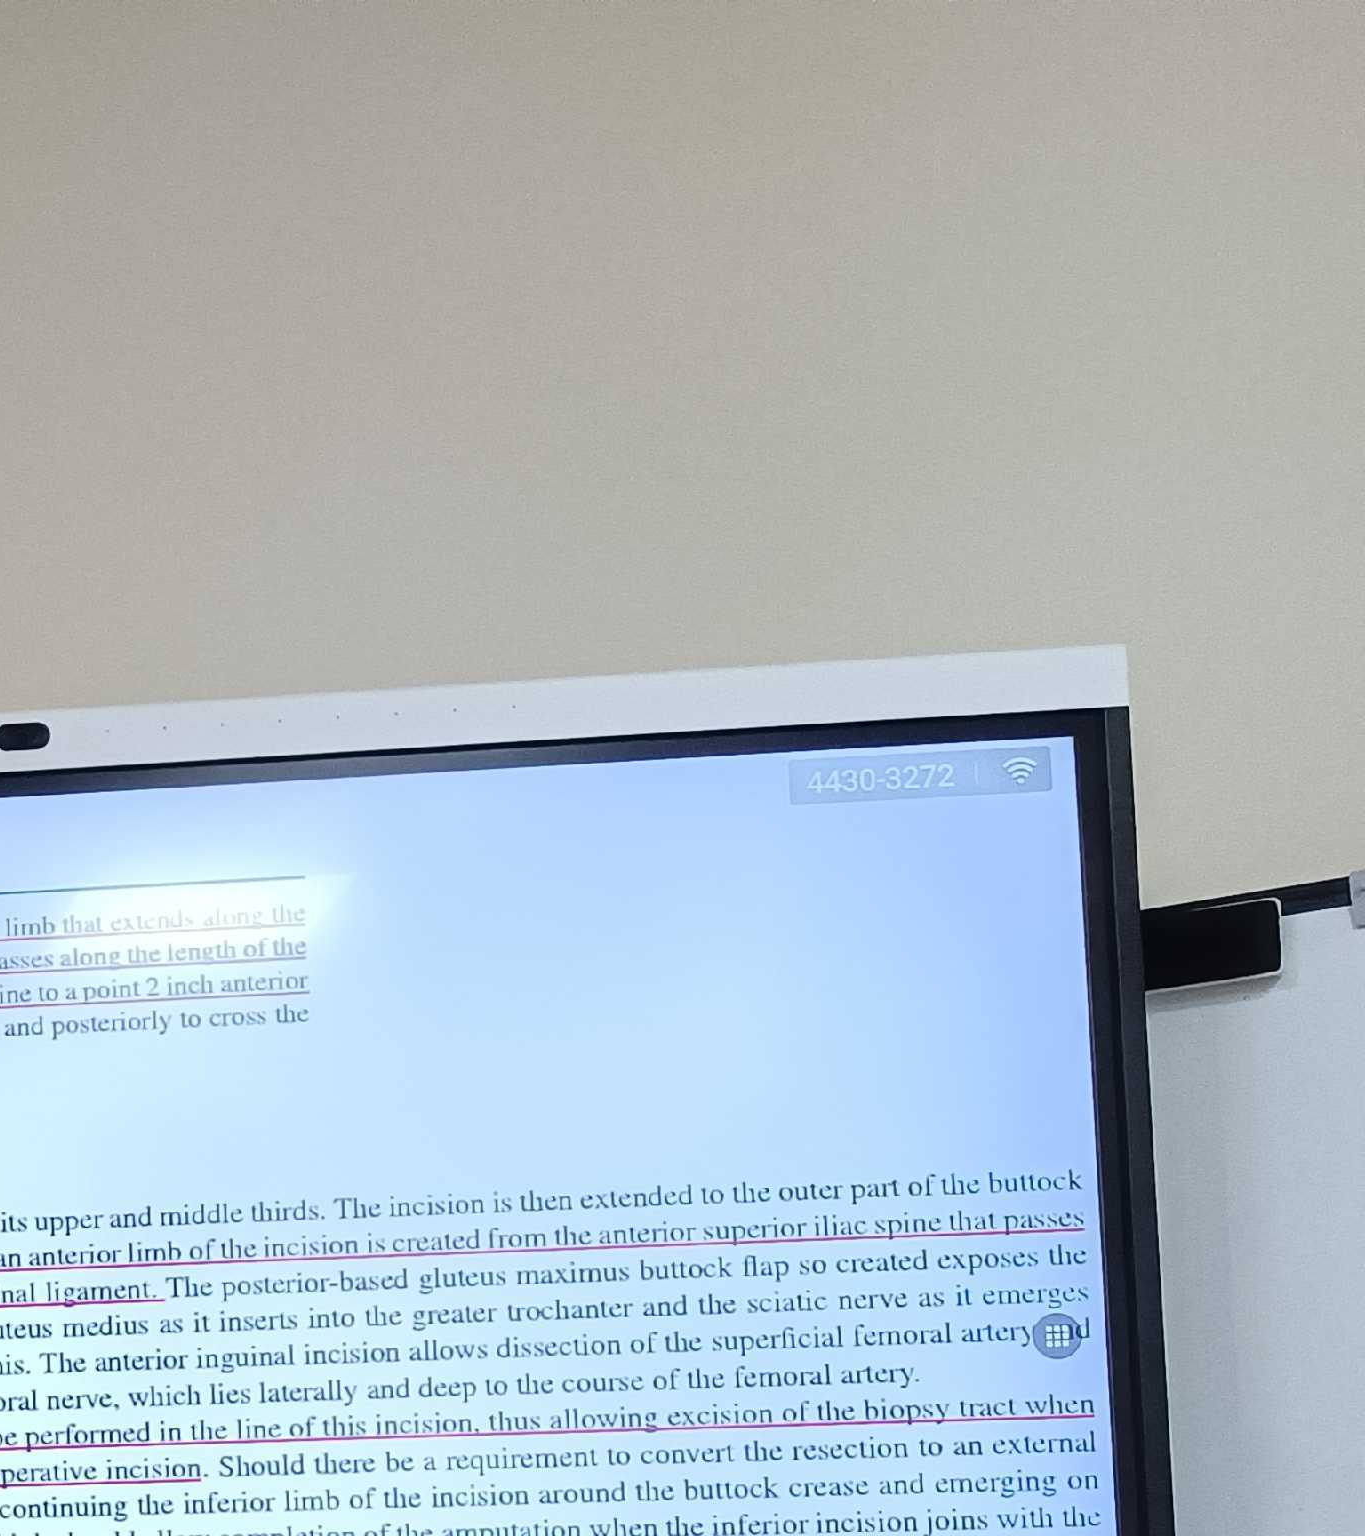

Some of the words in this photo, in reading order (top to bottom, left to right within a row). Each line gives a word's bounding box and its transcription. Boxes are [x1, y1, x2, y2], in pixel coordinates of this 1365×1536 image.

[806, 763, 956, 795] 4430-3272
[37, 986, 58, 1007] to
[63, 987, 76, 1006] a
[81, 979, 140, 1006] point
[144, 976, 159, 1003] 2
[165, 973, 213, 1002] inch
[218, 970, 308, 999] anterior
[2, 1015, 43, 1037] and
[50, 1010, 171, 1041] posteriorly
[179, 1012, 201, 1029] to
[207, 1010, 266, 1028] cross
[274, 1003, 308, 1024] the
[0, 1211, 27, 1233] its
[33, 1214, 103, 1237] upper
[108, 1205, 151, 1229] and
[158, 1203, 242, 1227] middle
[250, 1199, 324, 1223] thirds.
[332, 1197, 381, 1220] The
[388, 1193, 483, 1218] incision
[492, 1191, 512, 1213] is
[518, 1189, 572, 1213] then
[578, 1183, 692, 1210] extended
[700, 1187, 724, 1205] to
[731, 1181, 770, 1204] the
[777, 1183, 842, 1202] outer
[849, 1179, 898, 1205] part
[906, 1176, 935, 1197] of
[940, 1173, 979, 1196] the
[987, 1169, 1081, 1194] buttock
[136, 1493, 173, 1516] the
[183, 1491, 275, 1515] inferior
[283, 1489, 340, 1512] limb
[348, 1486, 377, 1510] of
[382, 1487, 421, 1509] the
[431, 1483, 529, 1509] incision
[537, 1480, 625, 1504] around
[634, 1480, 674, 1502] the
[683, 1476, 778, 1501] buttock
[787, 1480, 868, 1498] crease
[878, 1472, 924, 1495] and
[934, 1469, 1056, 1499] emerging
[1066, 1475, 1098, 1490] on
